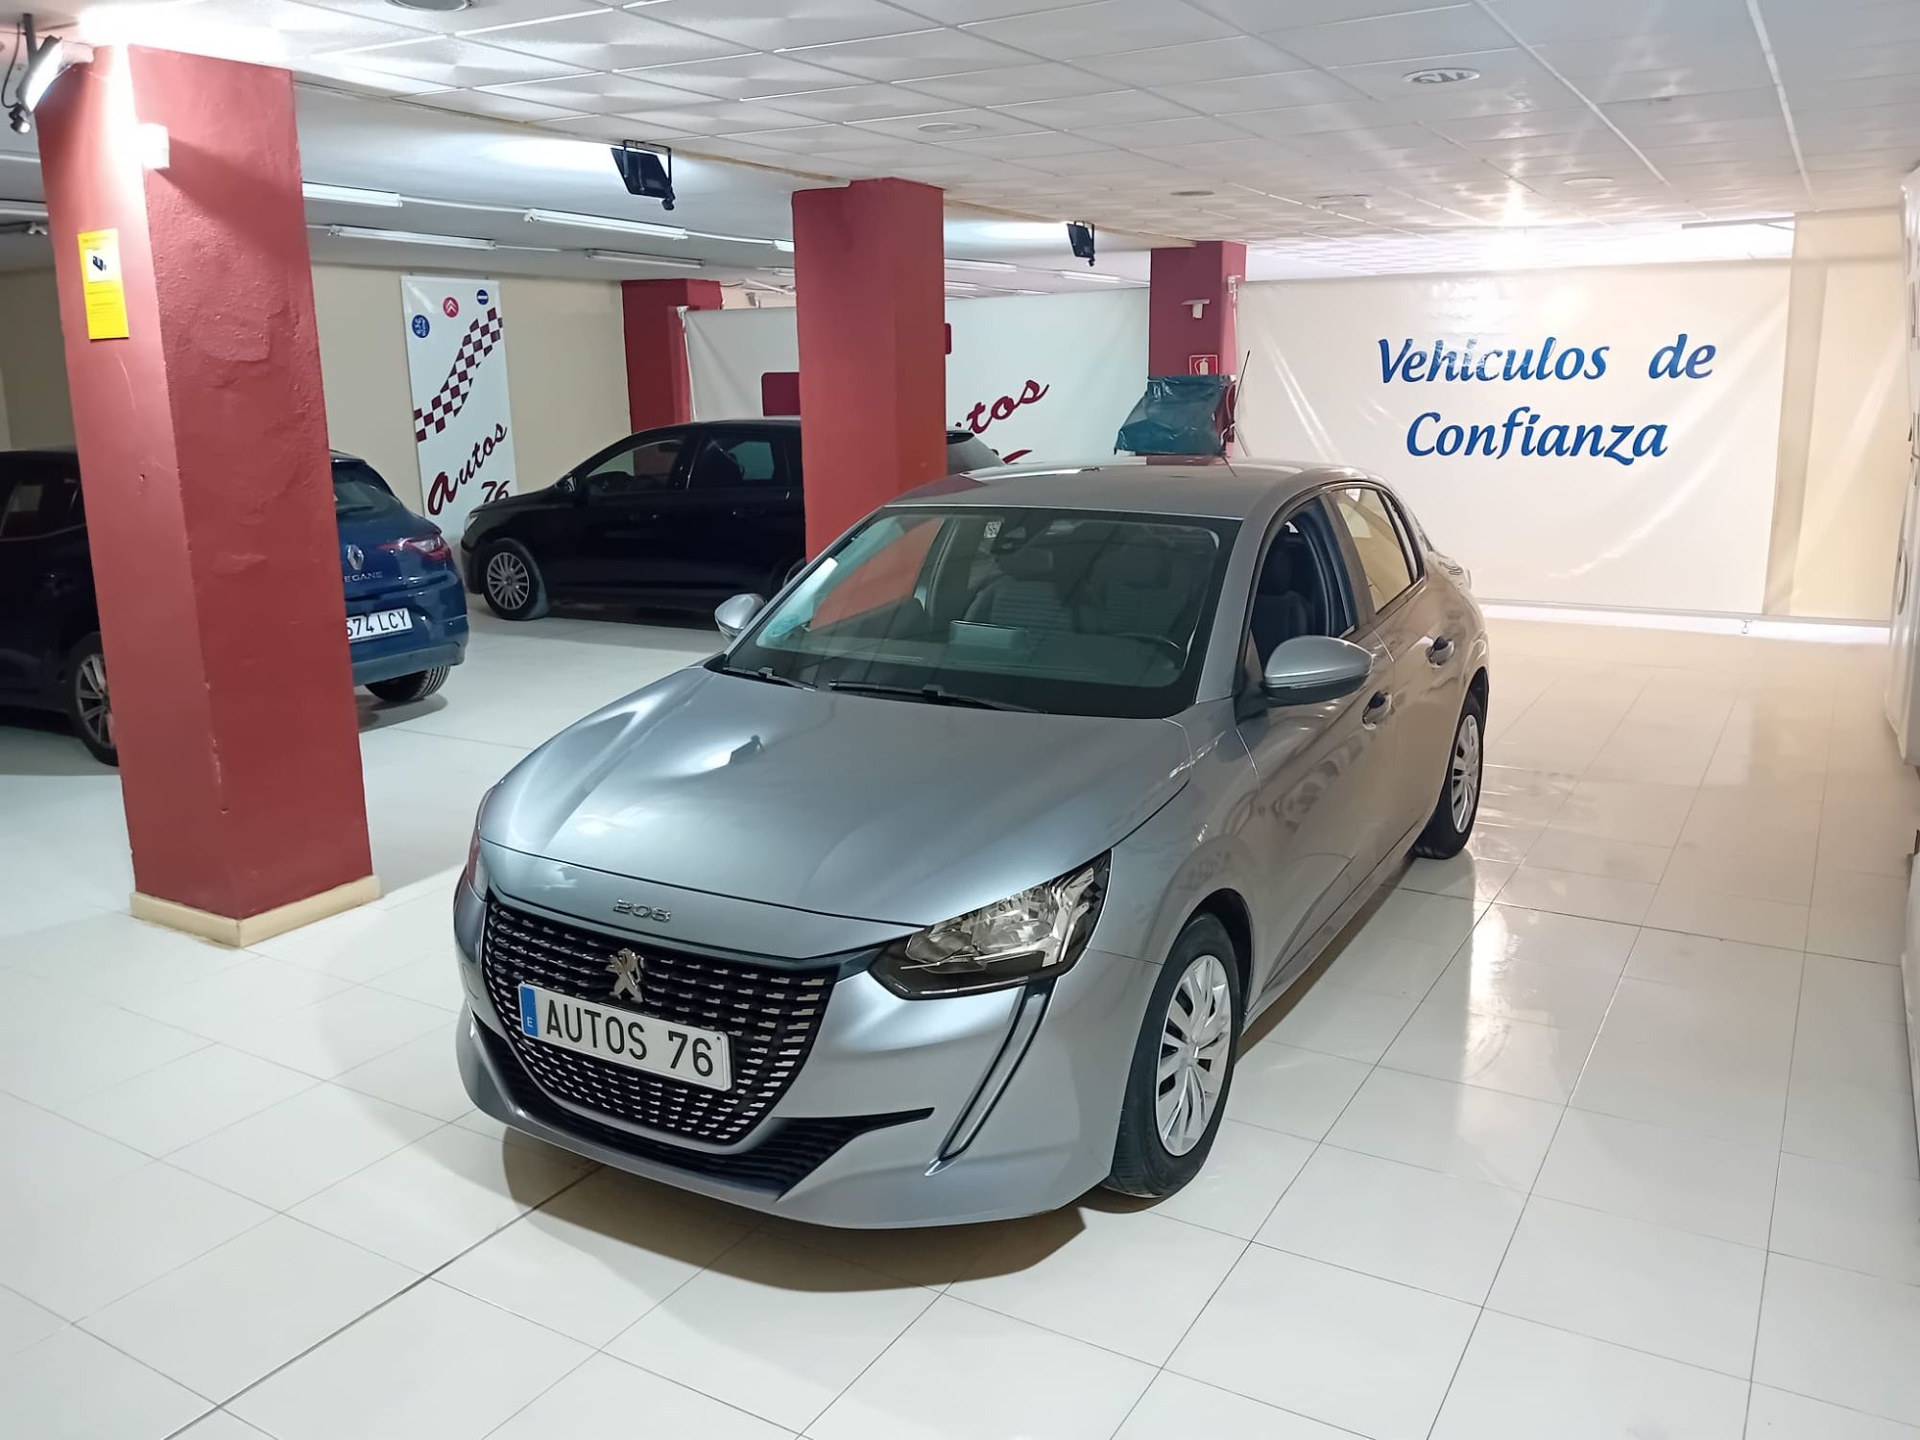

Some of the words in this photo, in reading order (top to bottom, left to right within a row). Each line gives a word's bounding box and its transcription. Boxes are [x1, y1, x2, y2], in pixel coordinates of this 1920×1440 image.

[1648, 333, 1717, 380] de
[954, 379, 1050, 434] tos
[1406, 406, 1669, 467] Confianza
[427, 422, 508, 516] Autos
[481, 480, 511, 504] 76
[343, 571, 383, 583] EGANE
[346, 616, 375, 638] 74
[377, 609, 407, 632] LCY
[612, 898, 671, 923] 208
[546, 999, 648, 1060] AUTOS
[667, 1030, 714, 1077] 76
